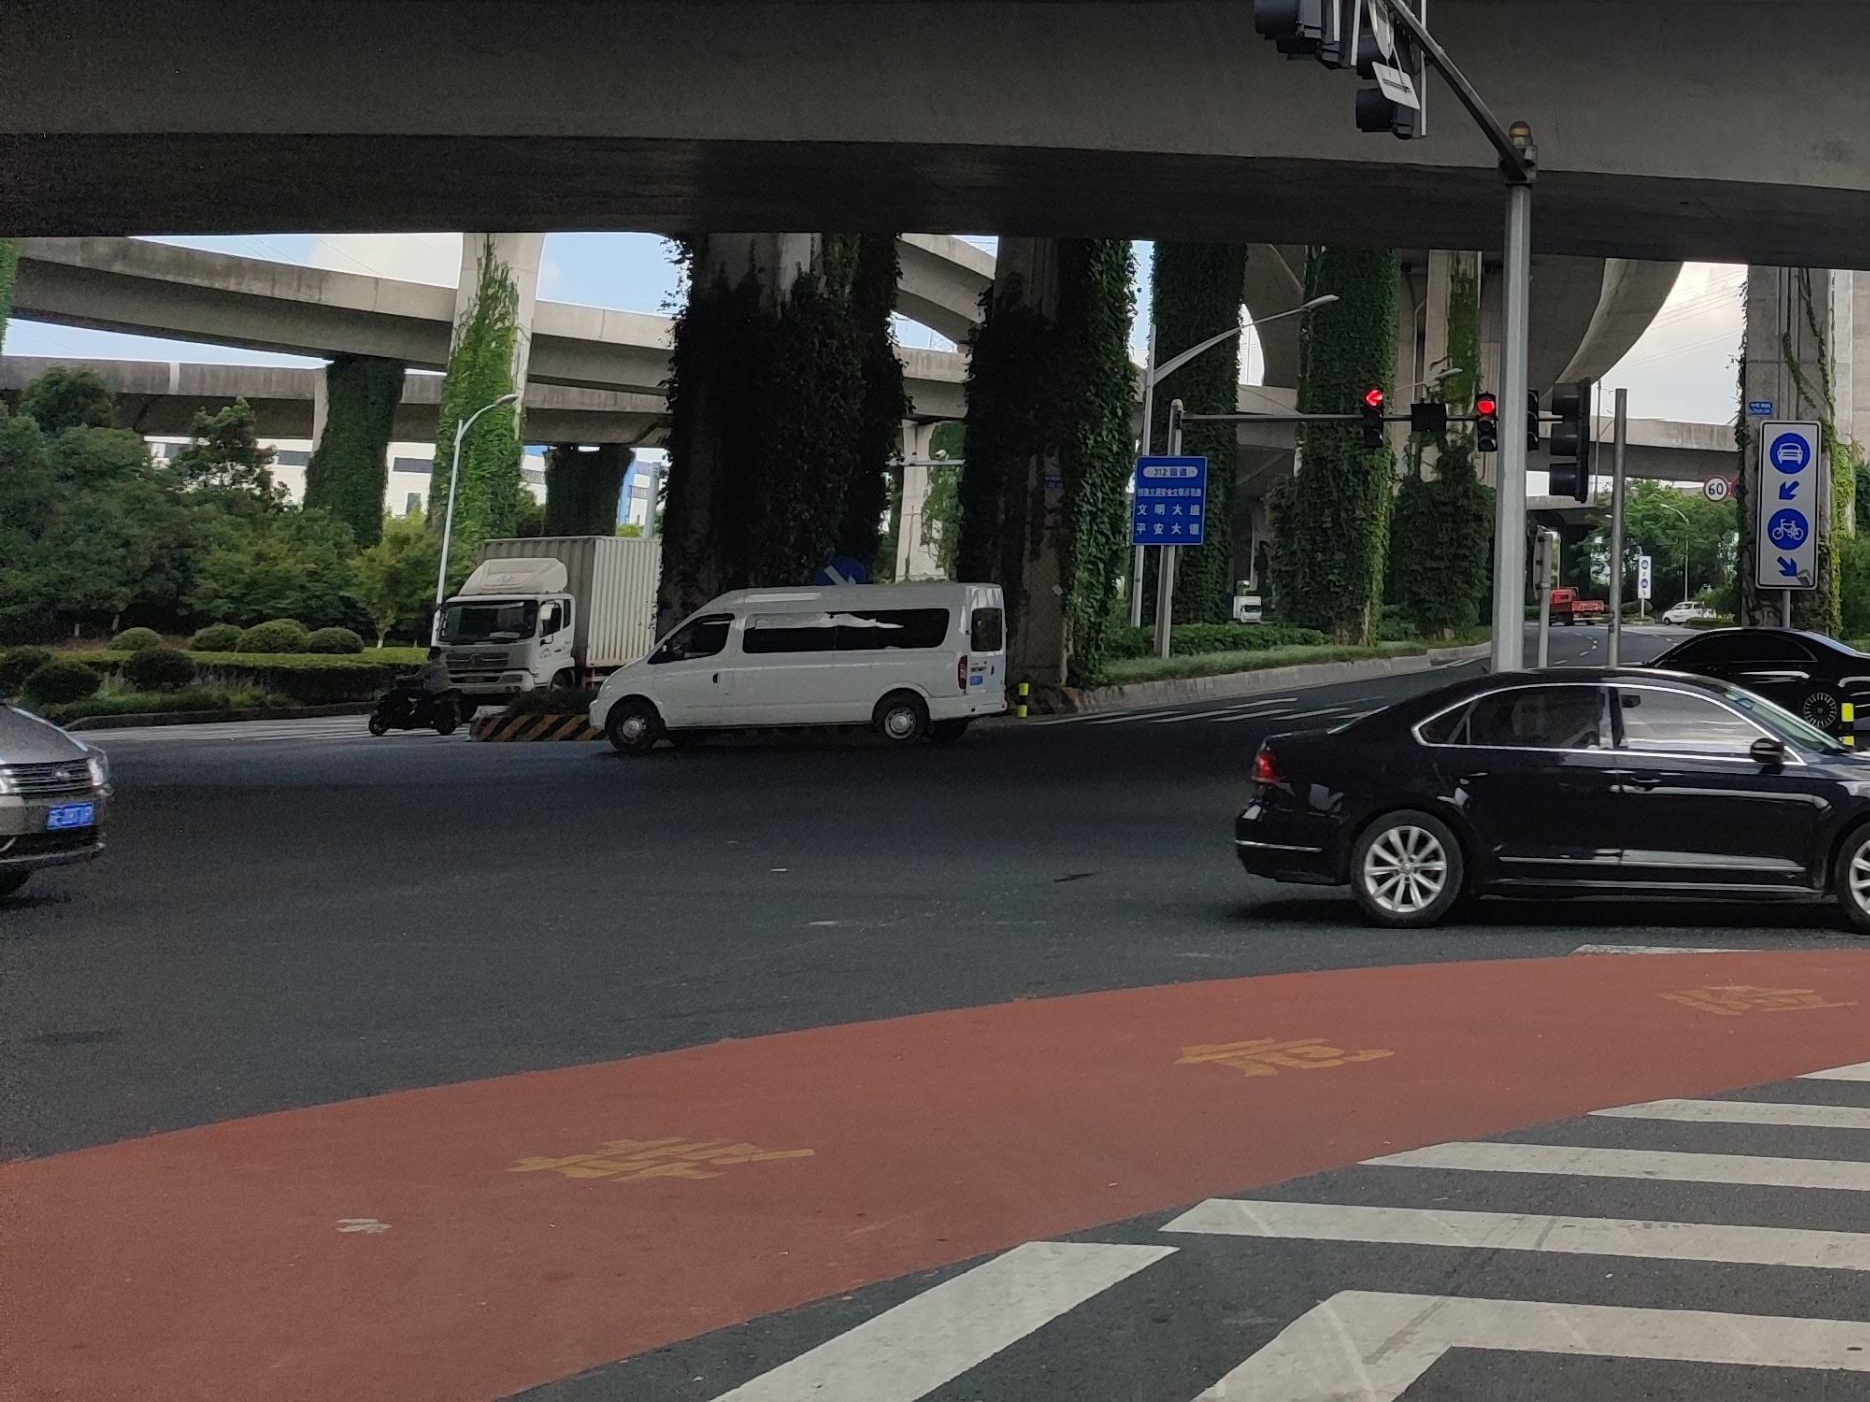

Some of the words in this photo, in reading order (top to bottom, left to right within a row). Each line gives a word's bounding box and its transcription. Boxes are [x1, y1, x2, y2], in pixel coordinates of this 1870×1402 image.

[1708, 482, 1724, 496] 60
[1136, 503, 1201, 516] 文明大道
[1135, 522, 1200, 536] 平安大道
